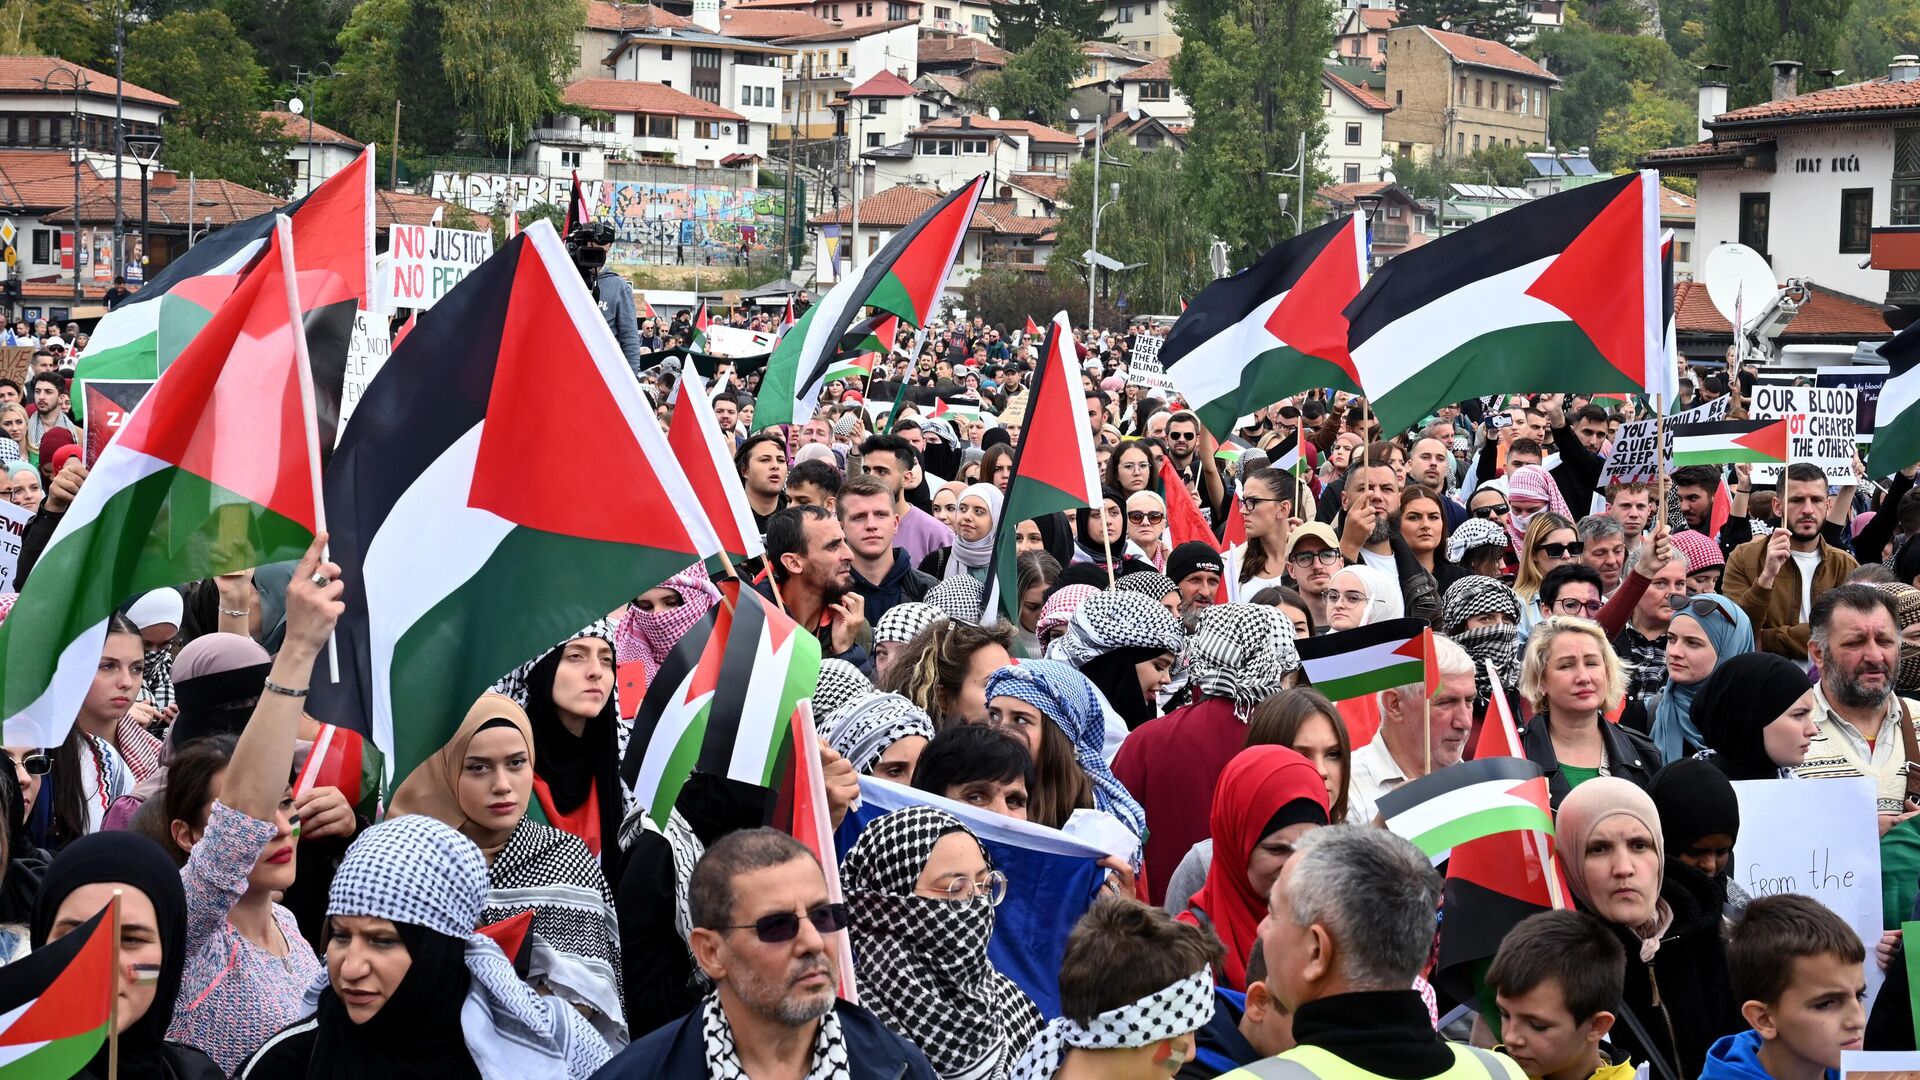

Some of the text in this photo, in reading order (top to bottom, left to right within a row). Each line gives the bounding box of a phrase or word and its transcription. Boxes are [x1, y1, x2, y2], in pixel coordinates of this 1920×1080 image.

[1796, 154, 1859, 173] INAT KUĆA
[394, 227, 487, 264] NO JUSTICE
[393, 264, 424, 299] NO
[367, 337, 389, 356] NOT
[1138, 336, 1153, 346] THE
[1134, 353, 1150, 363] THE
[1130, 374, 1145, 383] RIP
[1865, 381, 1882, 389] blood
[1757, 389, 1854, 415] OUR BLOOD
[1623, 422, 1648, 439] YOU
[1708, 398, 1726, 417] BE
[1809, 416, 1855, 437] CHEAPER
[1792, 438, 1855, 458] THE OTHERS
[1606, 466, 1636, 476] THEY
[1827, 466, 1851, 477] GAZA
[1808, 848, 1854, 890] the
